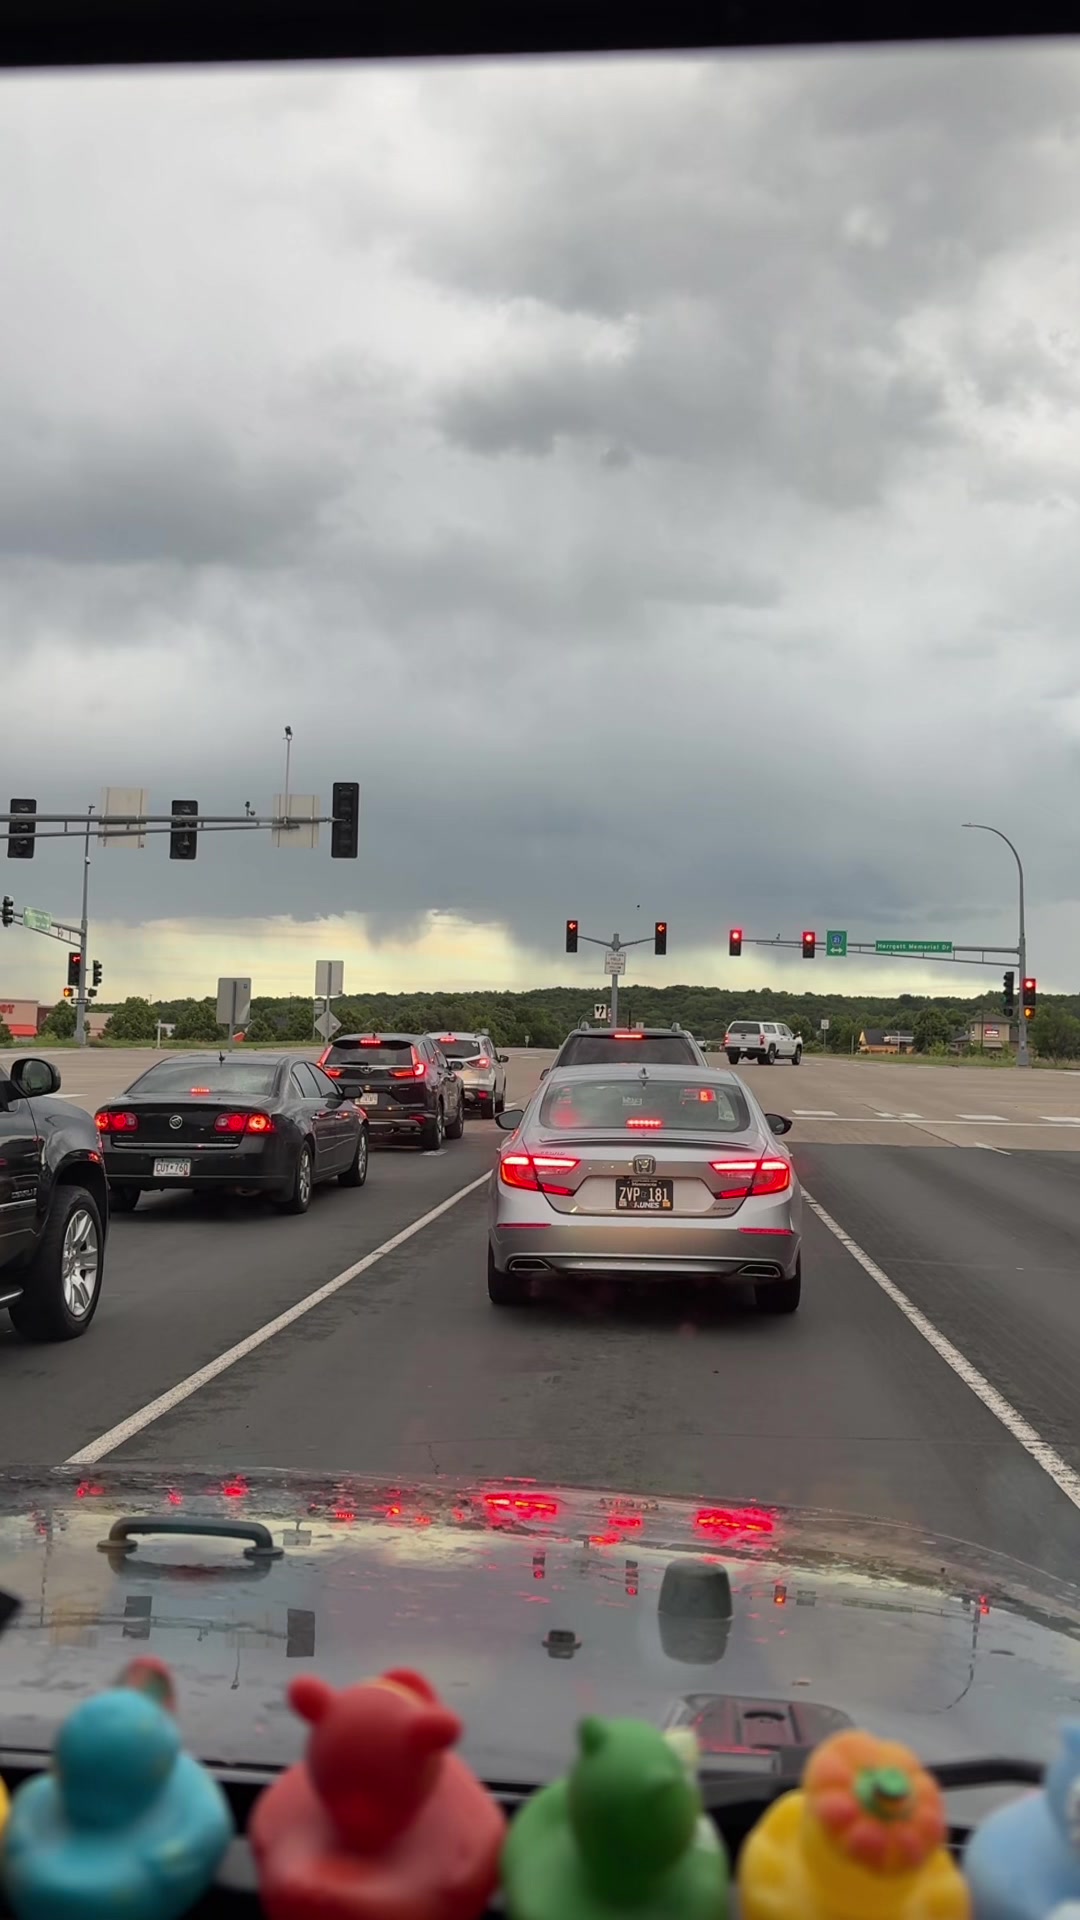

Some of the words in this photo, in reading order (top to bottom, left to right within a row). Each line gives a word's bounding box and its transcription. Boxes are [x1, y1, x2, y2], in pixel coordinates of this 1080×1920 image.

[833, 935, 841, 943] 21
[908, 943, 939, 951] Memorial
[619, 1186, 640, 1201] ZVP
[648, 1187, 669, 1202] 181
